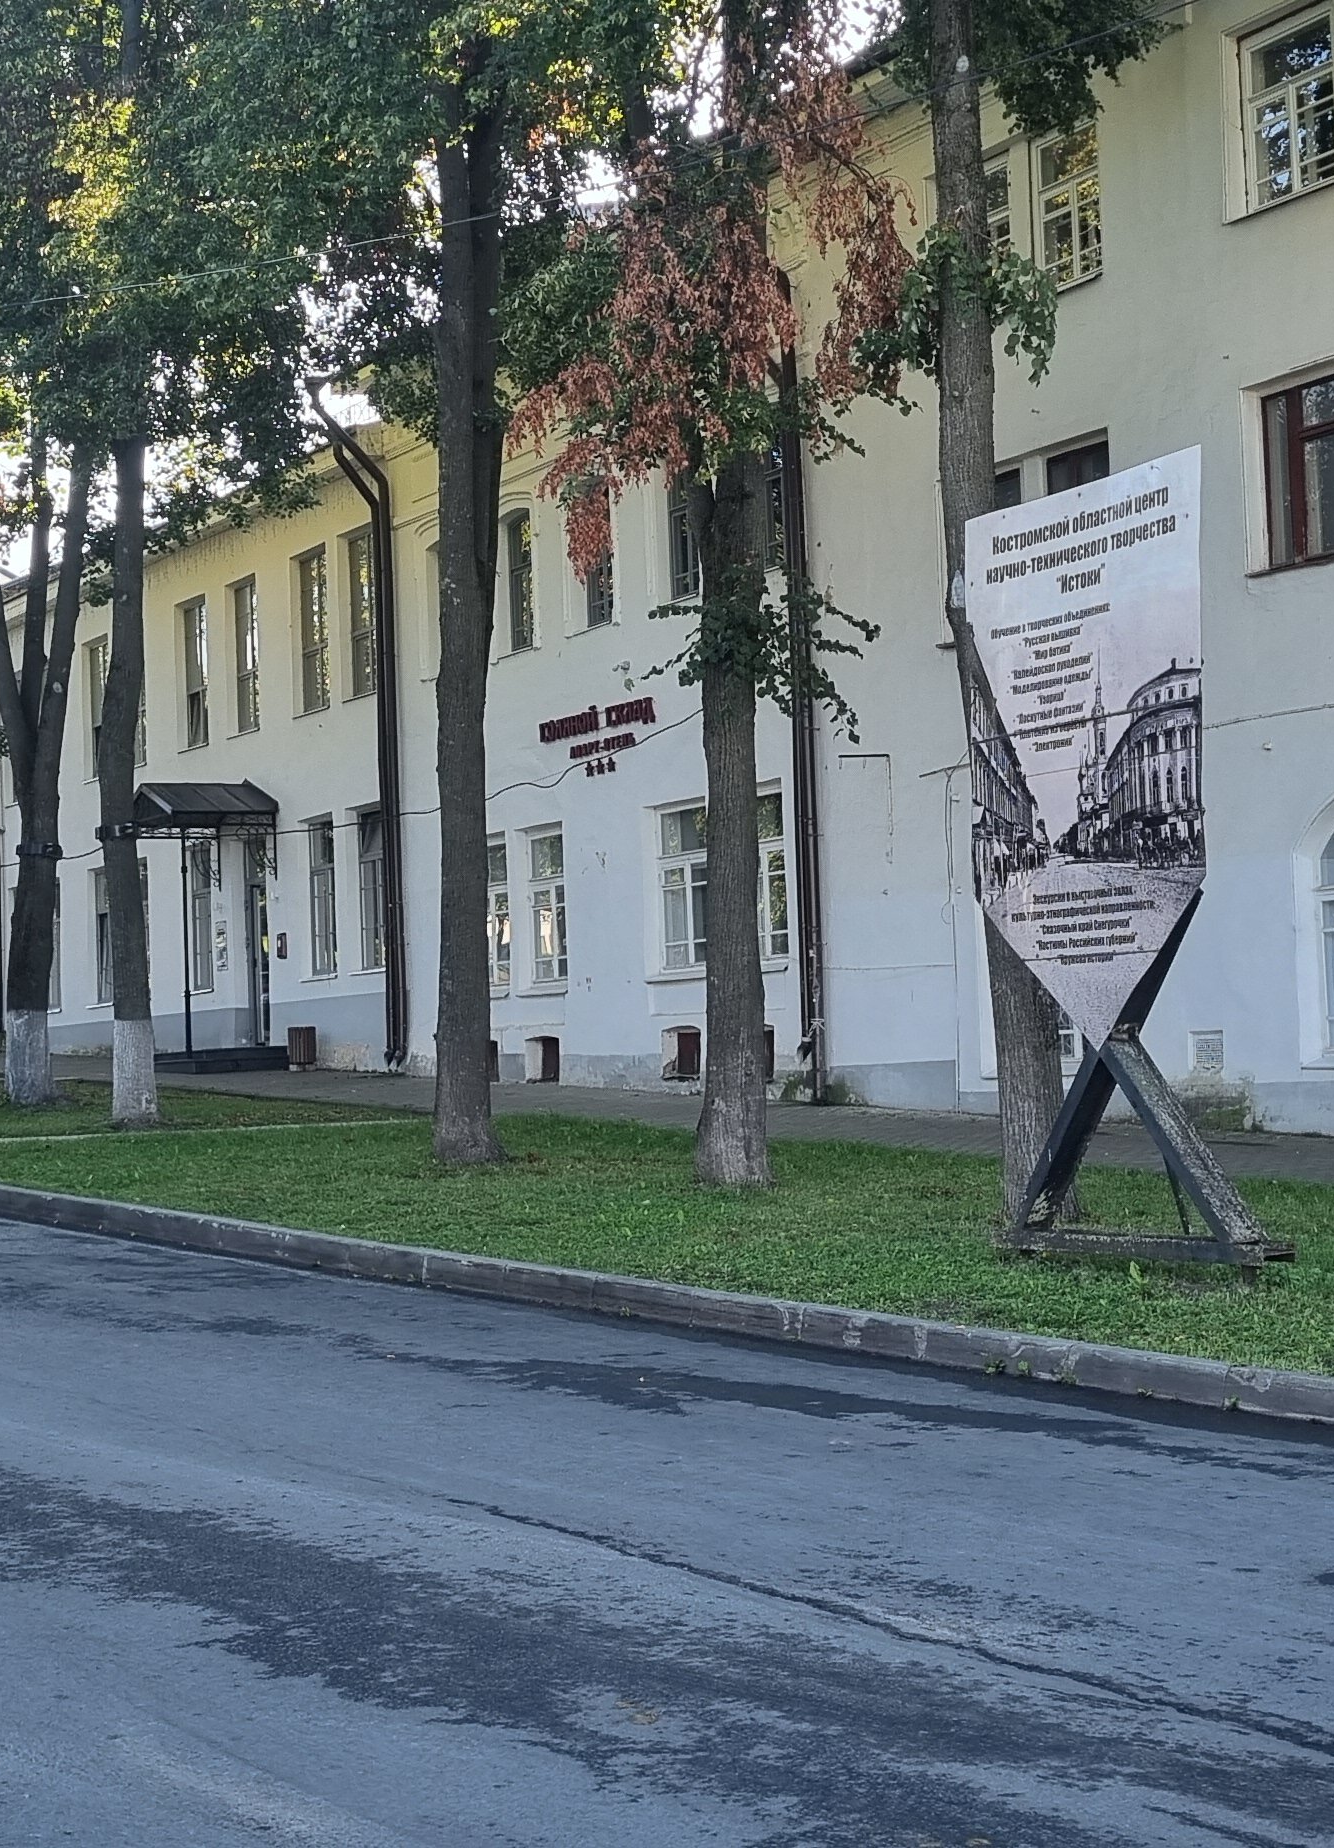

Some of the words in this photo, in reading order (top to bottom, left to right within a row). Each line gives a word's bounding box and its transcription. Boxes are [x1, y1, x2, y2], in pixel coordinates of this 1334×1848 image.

[992, 515, 1069, 555] Костромской
[1072, 494, 1132, 533] областной
[1134, 486, 1169, 515] центр
[986, 537, 1107, 585] научно-технического
[1110, 515, 1176, 551] творчества
[990, 625, 1021, 639] Обучение
[1027, 615, 1063, 632] творческих
[605, 697, 656, 727] СКЛАД
[569, 732, 636, 759] АПАРТ-ОТЕЛЬ
